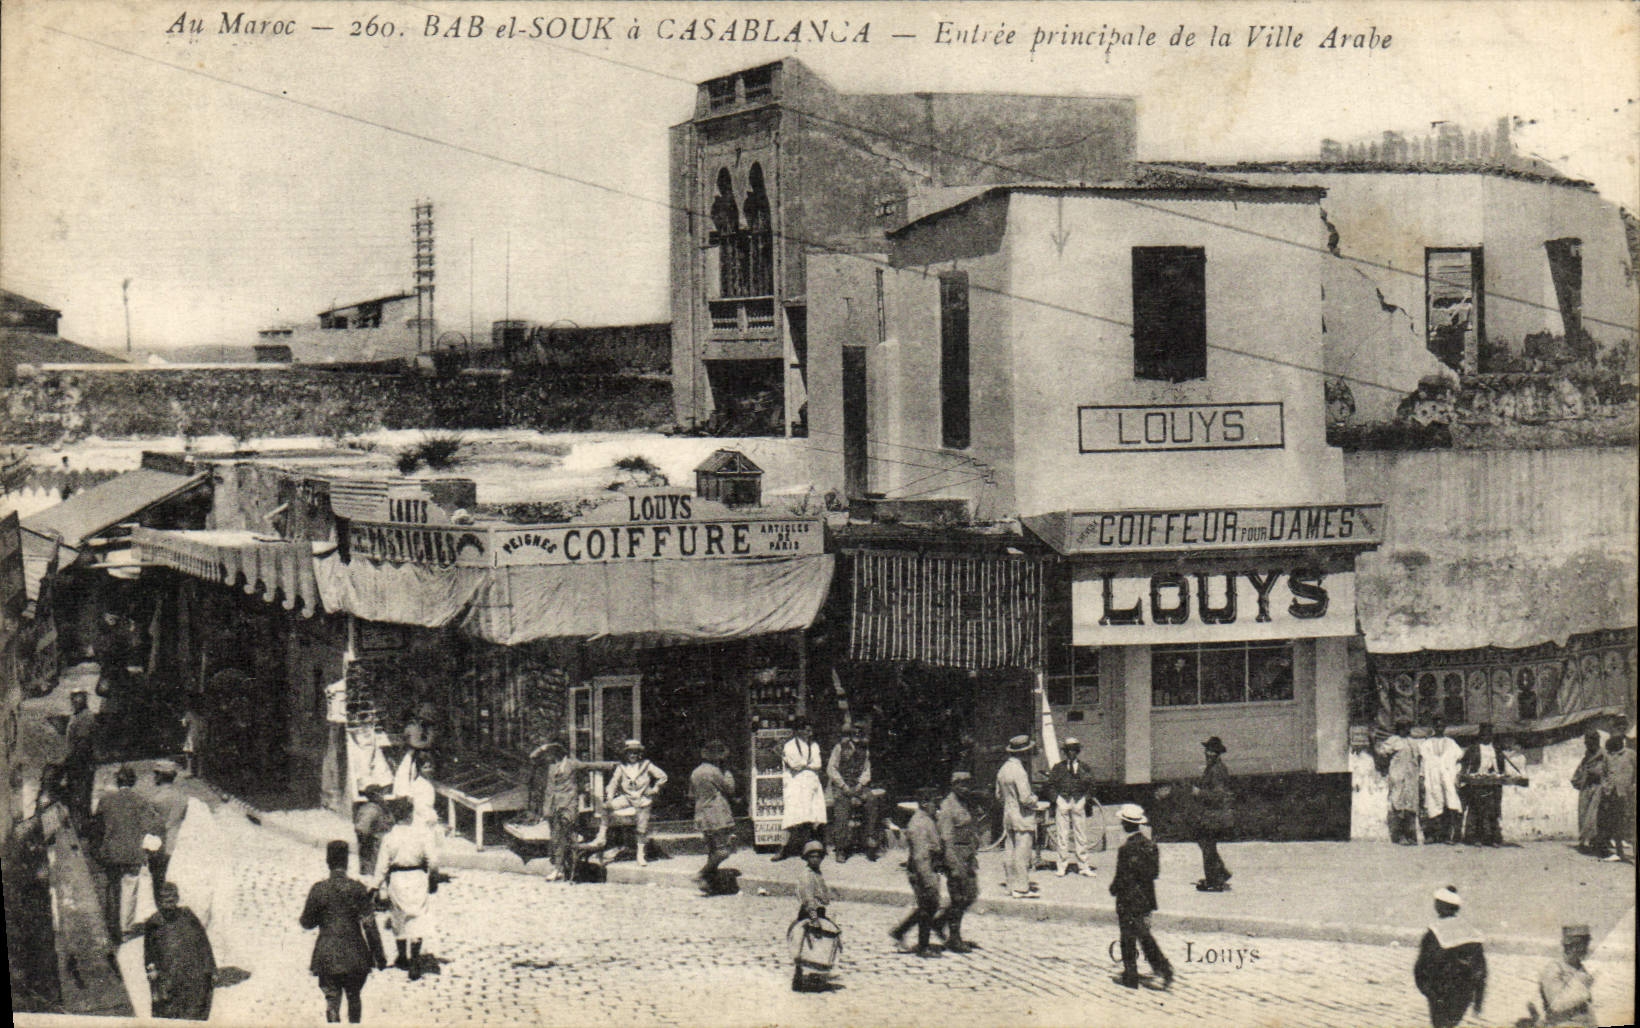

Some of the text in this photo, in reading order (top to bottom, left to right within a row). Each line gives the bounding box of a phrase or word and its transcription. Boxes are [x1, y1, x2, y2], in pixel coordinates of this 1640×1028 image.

[1118, 410, 1245, 445] LOUYS
[629, 494, 692, 522] LOUYS
[760, 523, 809, 533] ARTICLES
[777, 532, 790, 542] DE
[1099, 510, 1238, 546] COIFFEUR
[1241, 526, 1267, 542] POUR
[1269, 506, 1355, 541] DAMES
[502, 533, 557, 554] PEIGNES
[563, 524, 751, 561] COIFFURE
[769, 541, 800, 550] PARIS
[1098, 569, 1330, 626] LOUYS
